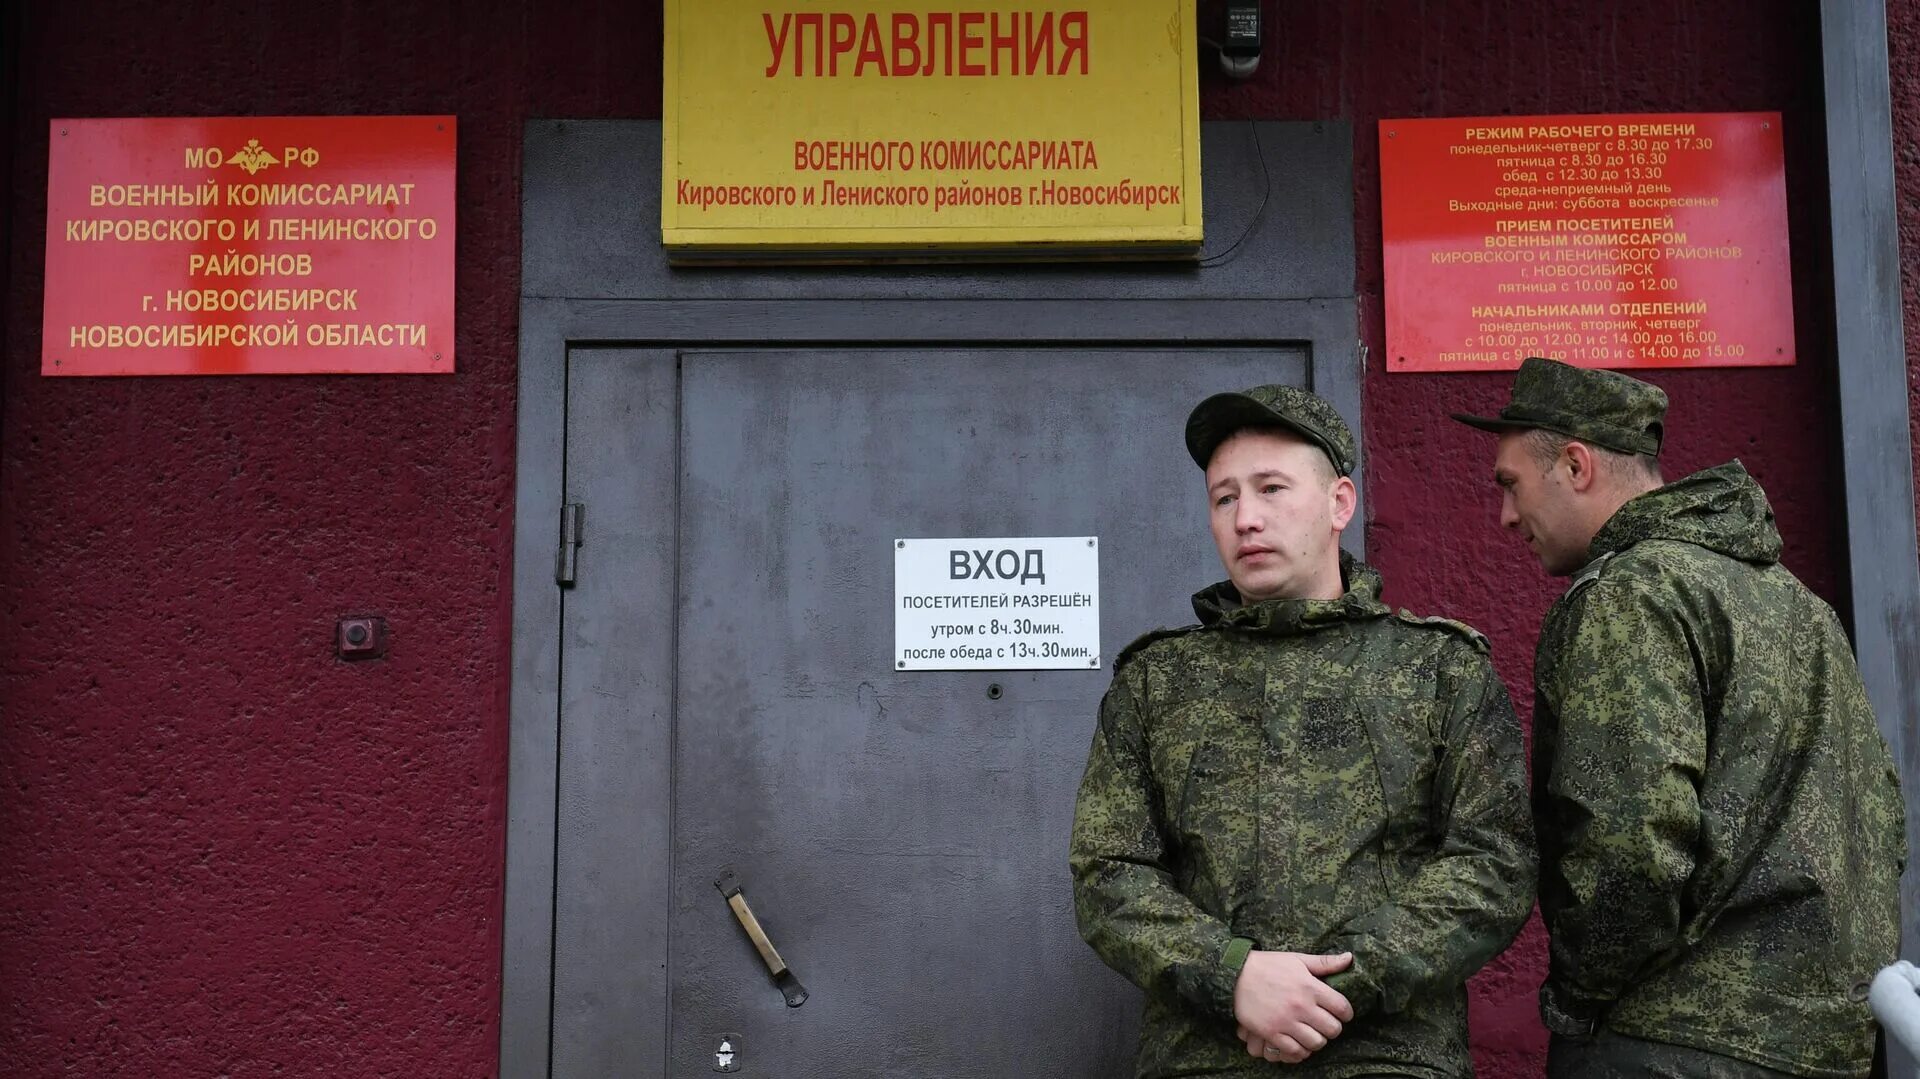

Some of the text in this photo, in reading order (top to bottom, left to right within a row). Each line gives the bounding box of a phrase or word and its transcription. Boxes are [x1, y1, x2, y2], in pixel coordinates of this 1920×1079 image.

[763, 12, 1089, 78] УПРАВЛЕНИЯ
[1466, 124, 1695, 139] РЕЖИМ РАБОЧЕГО ВРЕМЕНИ
[794, 140, 1098, 171] ВОЕННОГО КОМИССАРИАТА
[1450, 138, 1713, 155] понедельник-четверг с 8.30 до 17.30
[185, 147, 320, 169] МО РФ
[1497, 153, 1667, 168] пятница с 8.30 до 16.30
[1503, 167, 1662, 182] обед с 12.30 до 13.30
[90, 178, 414, 206] ВОЕННЫЙ КОМИССАРИАТ
[676, 179, 1180, 212] Кировского и Лениского районов г.Новосибирск
[1495, 182, 1672, 198] среда-неприемный день
[1449, 196, 1720, 212] Выходные дни: суббота воскресенье
[66, 218, 437, 241] КИРОВСКОГО И ЛЕНИНСКОГО
[1496, 214, 1674, 232] ПРИЕМ ПОСЕТИТЕЛЕЙ
[1485, 232, 1687, 247] ВОЕННЫМ КОМИССАРОМ
[189, 248, 312, 276] РАЙОНОВ
[1431, 251, 1535, 264] КИРОВСКОГО
[1539, 251, 1550, 261] И
[1555, 248, 1661, 262] ЛЕНИНСКОГО
[1521, 263, 1654, 278] г. НОВОСИБИРСК
[1498, 278, 1678, 293] пятница с 10.00 до 12.00
[142, 289, 357, 312] г. НОВОСИБИРСК
[1471, 299, 1707, 318] НАЧАЛЬНИКАМИ ОТДЕЛЕНИЙ
[70, 319, 427, 348] НОВОСИБИРСКОЙ ОБЛАСТИ
[1581, 320, 1642, 332] вторник,
[1646, 319, 1701, 330] четверг
[1465, 331, 1716, 347] с 10.00 до 12.00 и с 14.00 до 16.00
[1439, 352, 1497, 363] пятница
[1502, 351, 1510, 360] с
[1549, 350, 1567, 361] до
[1574, 347, 1609, 359] 11.00
[1614, 349, 1622, 358] и
[1627, 349, 1635, 358] с
[1640, 347, 1678, 358] 14.00
[1682, 348, 1701, 358] до
[1706, 345, 1744, 357] 15.00
[949, 549, 1045, 586] ВХОД
[903, 592, 1091, 609] ПОСЕТИТЕЛЕЙ РАЗРЕШЁН
[931, 618, 1064, 639] утром с 8ч.30мин.
[904, 641, 1092, 661] после обеда с 13ч.30мин.
